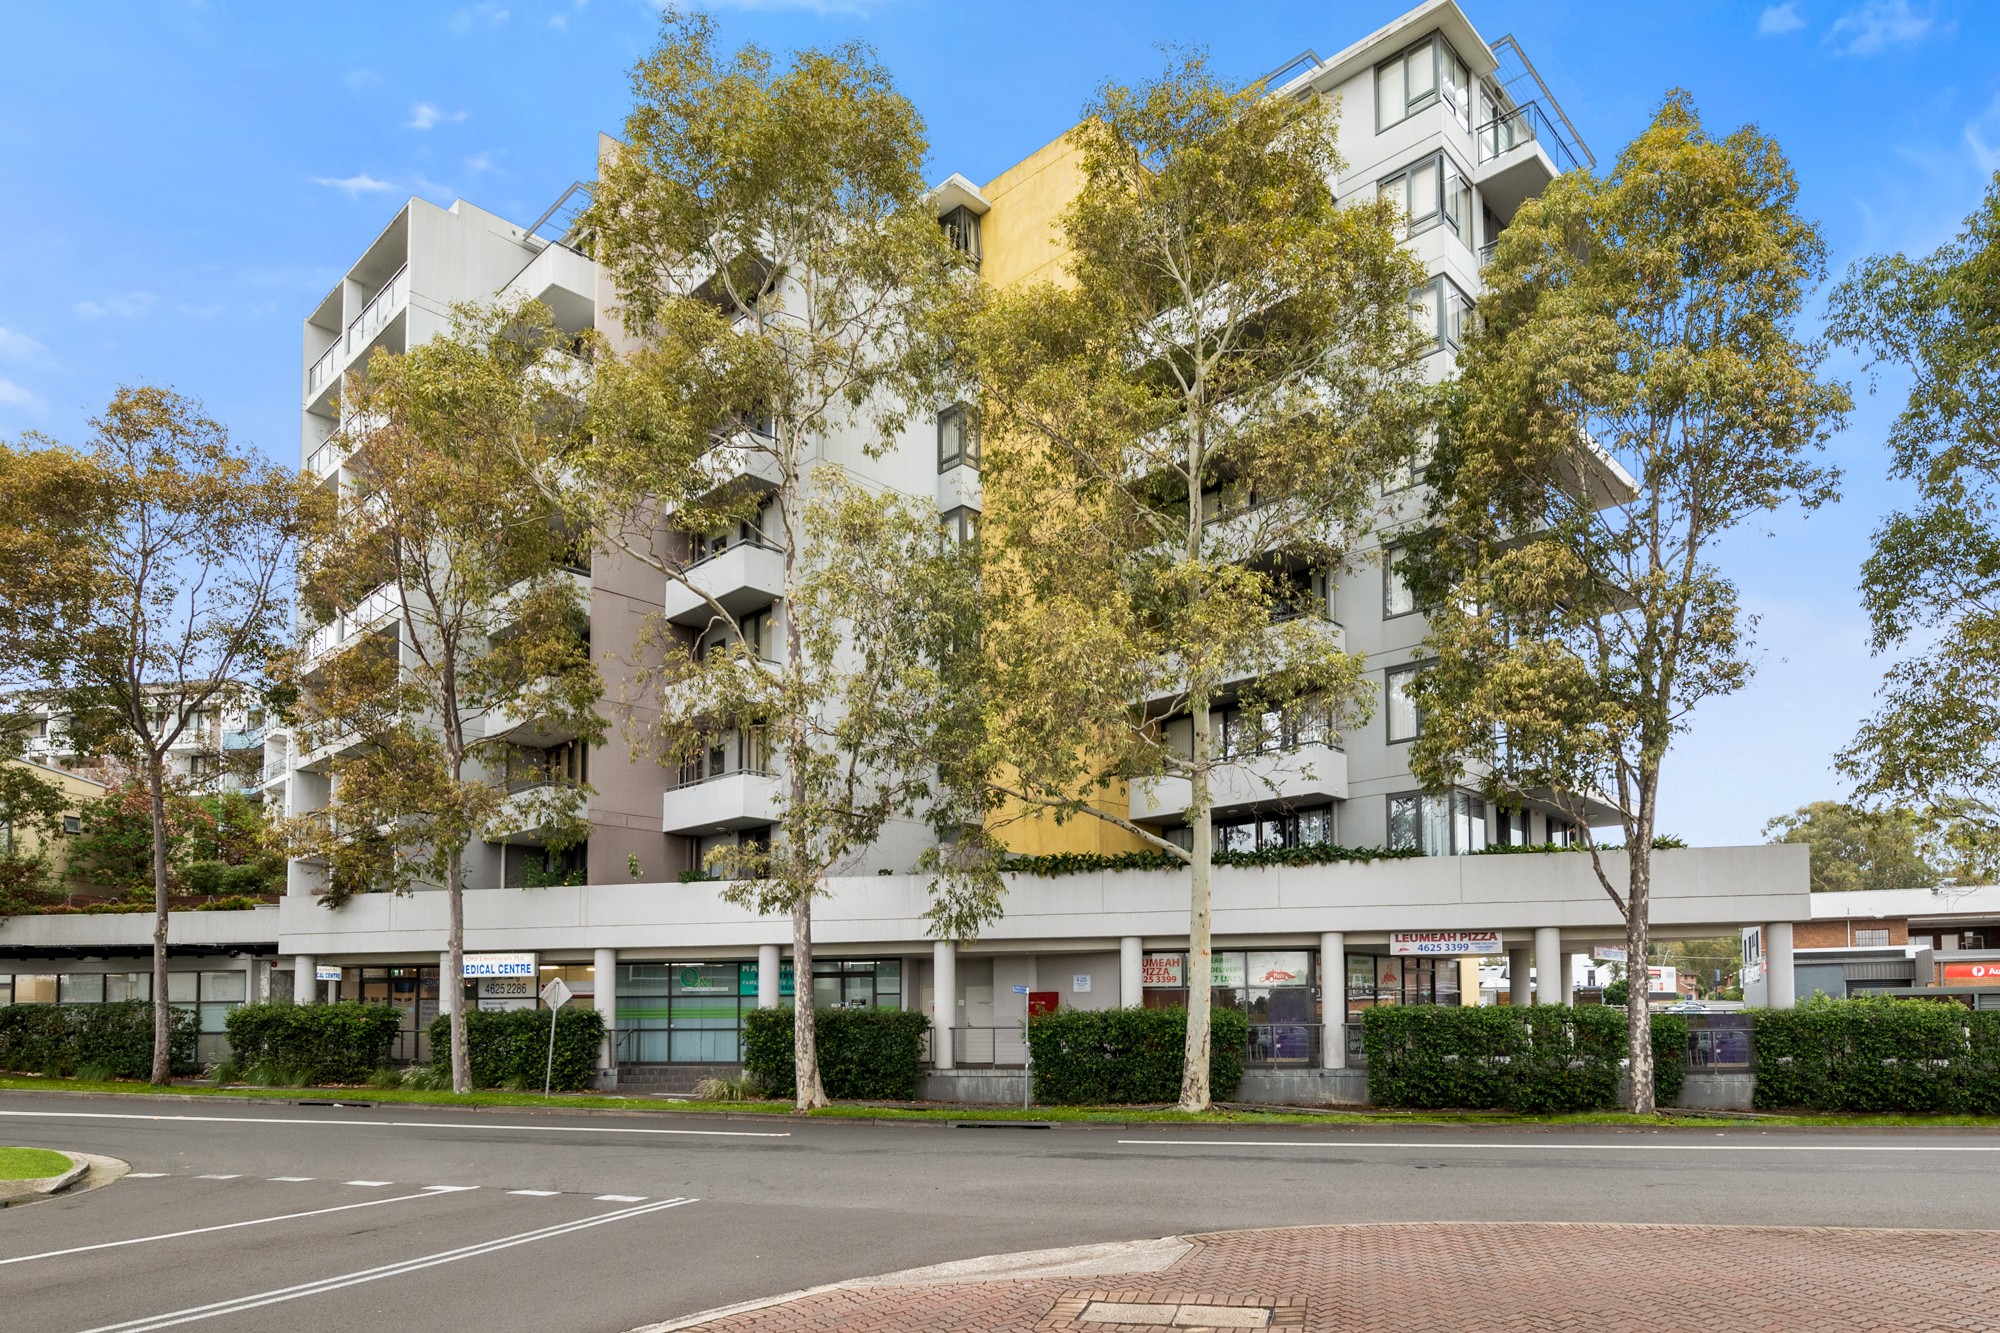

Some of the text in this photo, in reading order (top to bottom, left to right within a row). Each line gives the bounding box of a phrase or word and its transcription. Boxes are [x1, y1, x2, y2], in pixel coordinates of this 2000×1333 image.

[1395, 932, 1498, 943] LEUMEAH PIZZA
[1417, 943, 1469, 952] 4625 3399
[1142, 958, 1180, 967] UMEAH
[498, 963, 532, 974] CENTRE
[485, 983, 527, 995] 4625 2286
